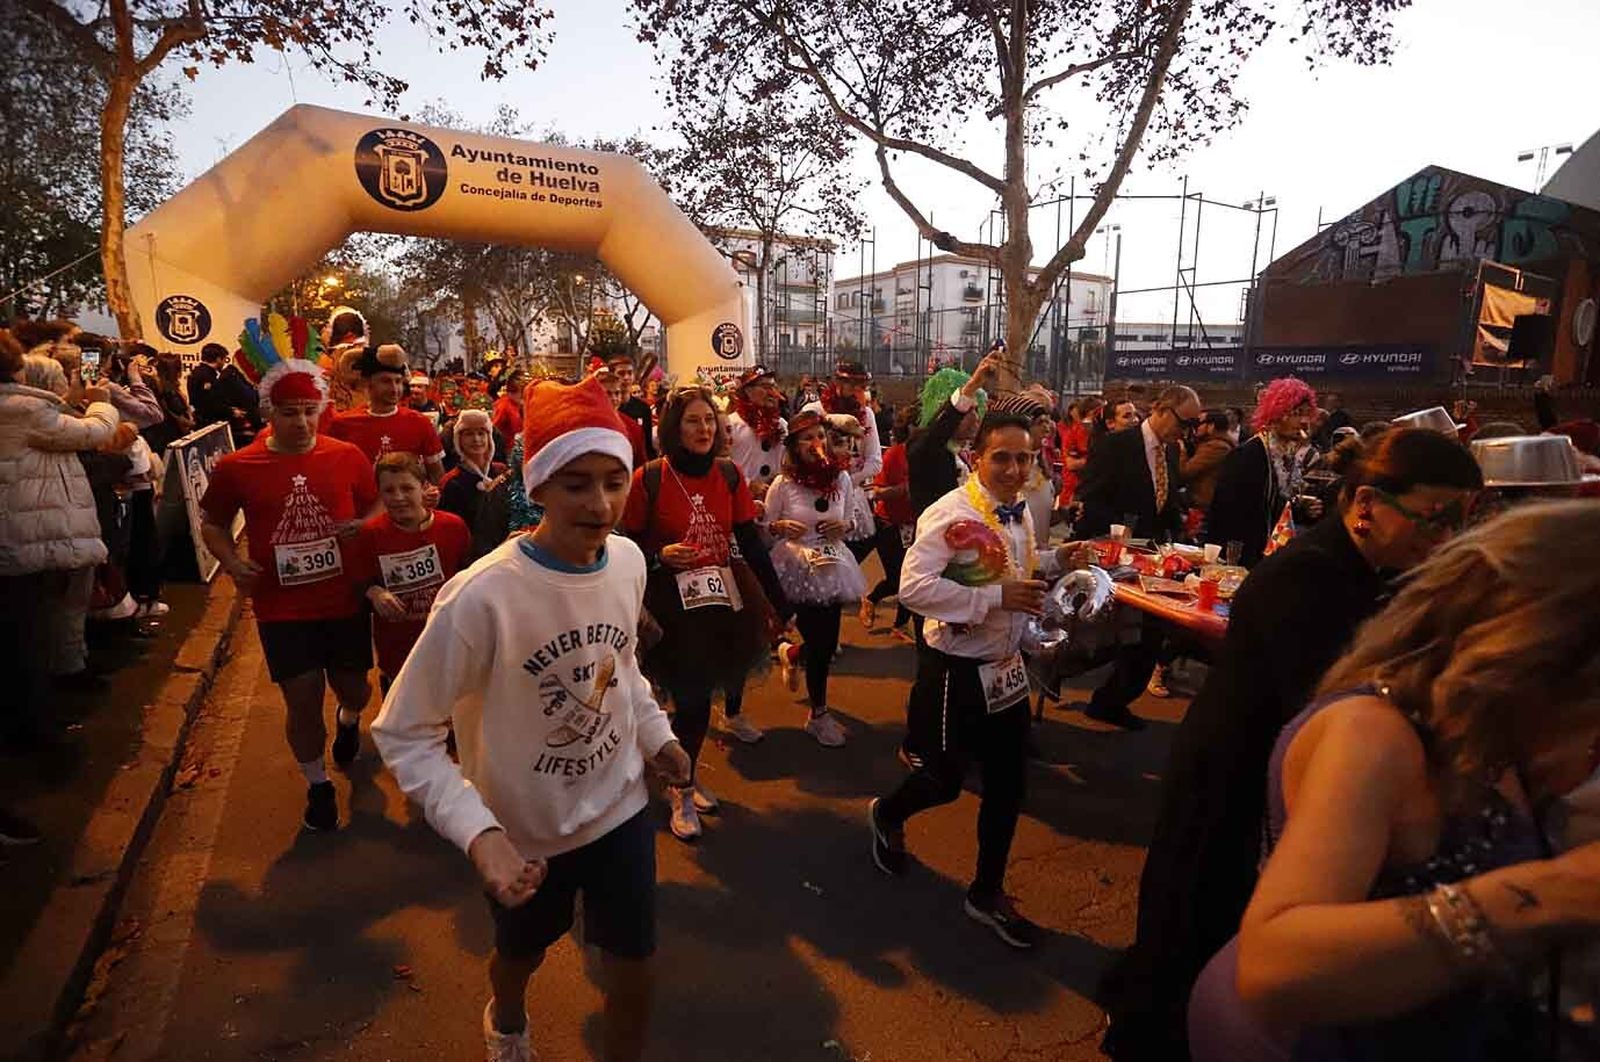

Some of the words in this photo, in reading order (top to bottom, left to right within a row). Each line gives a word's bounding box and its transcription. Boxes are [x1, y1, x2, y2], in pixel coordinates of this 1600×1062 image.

[451, 144, 599, 175] Ayuntamiento
[496, 167, 522, 184] de
[530, 170, 600, 193] Huelva
[531, 192, 546, 202] de
[550, 193, 603, 208] Deportes
[1131, 357, 1167, 365] HYUNDAI
[1192, 355, 1234, 364] HYUNDAI
[1276, 354, 1326, 364] HYUNDAI
[1363, 353, 1422, 363] HYUNDAI
[303, 551, 335, 571] 390
[406, 559, 435, 579] 389
[523, 630, 583, 676] NEVER
[586, 623, 628, 653] BETTER
[1006, 666, 1024, 690] 456
[533, 729, 621, 776] LIFESTYLE
